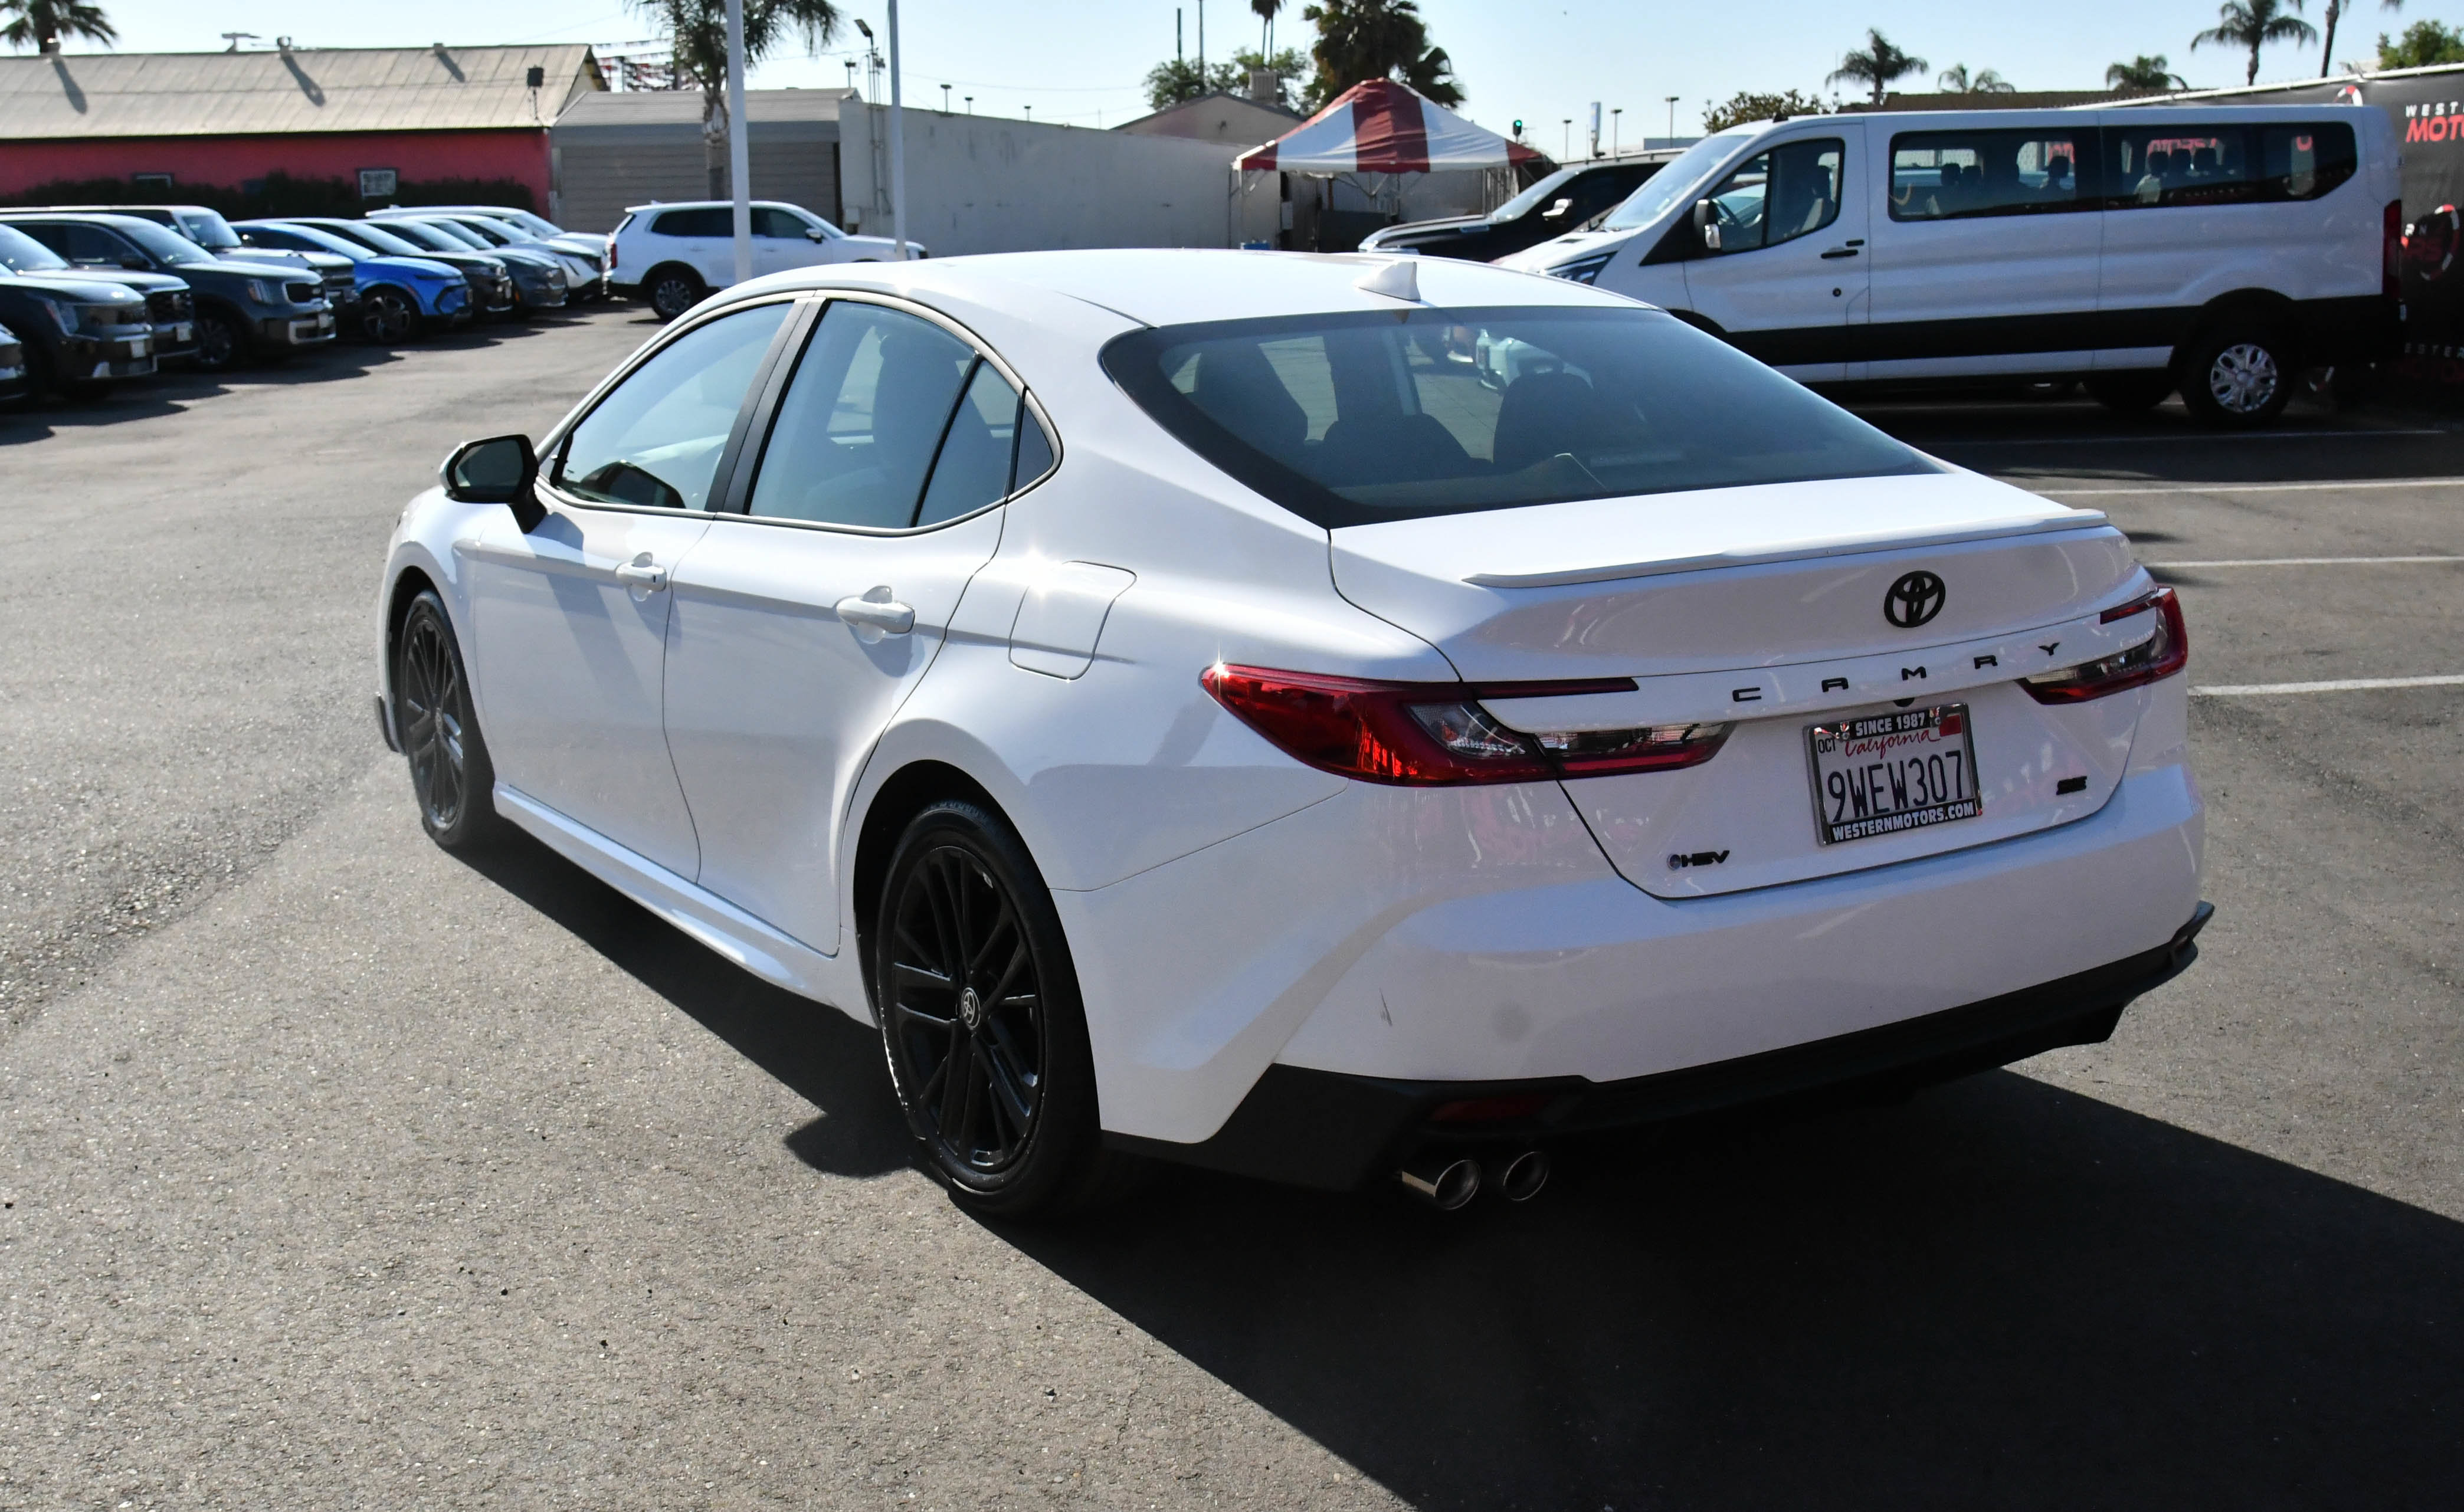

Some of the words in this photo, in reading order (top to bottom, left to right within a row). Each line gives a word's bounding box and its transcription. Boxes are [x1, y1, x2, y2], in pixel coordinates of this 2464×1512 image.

[2406, 101, 2464, 118] WEST
[2406, 114, 2464, 143] MOT
[1732, 642, 2060, 702] CAMRY
[1855, 717, 1892, 737] SINCE
[1895, 712, 1925, 730] 1987
[1844, 728, 1941, 760] California
[1827, 750, 1962, 822] 9WEW307
[1832, 802, 1974, 842] WESTERNMOTORS.COM
